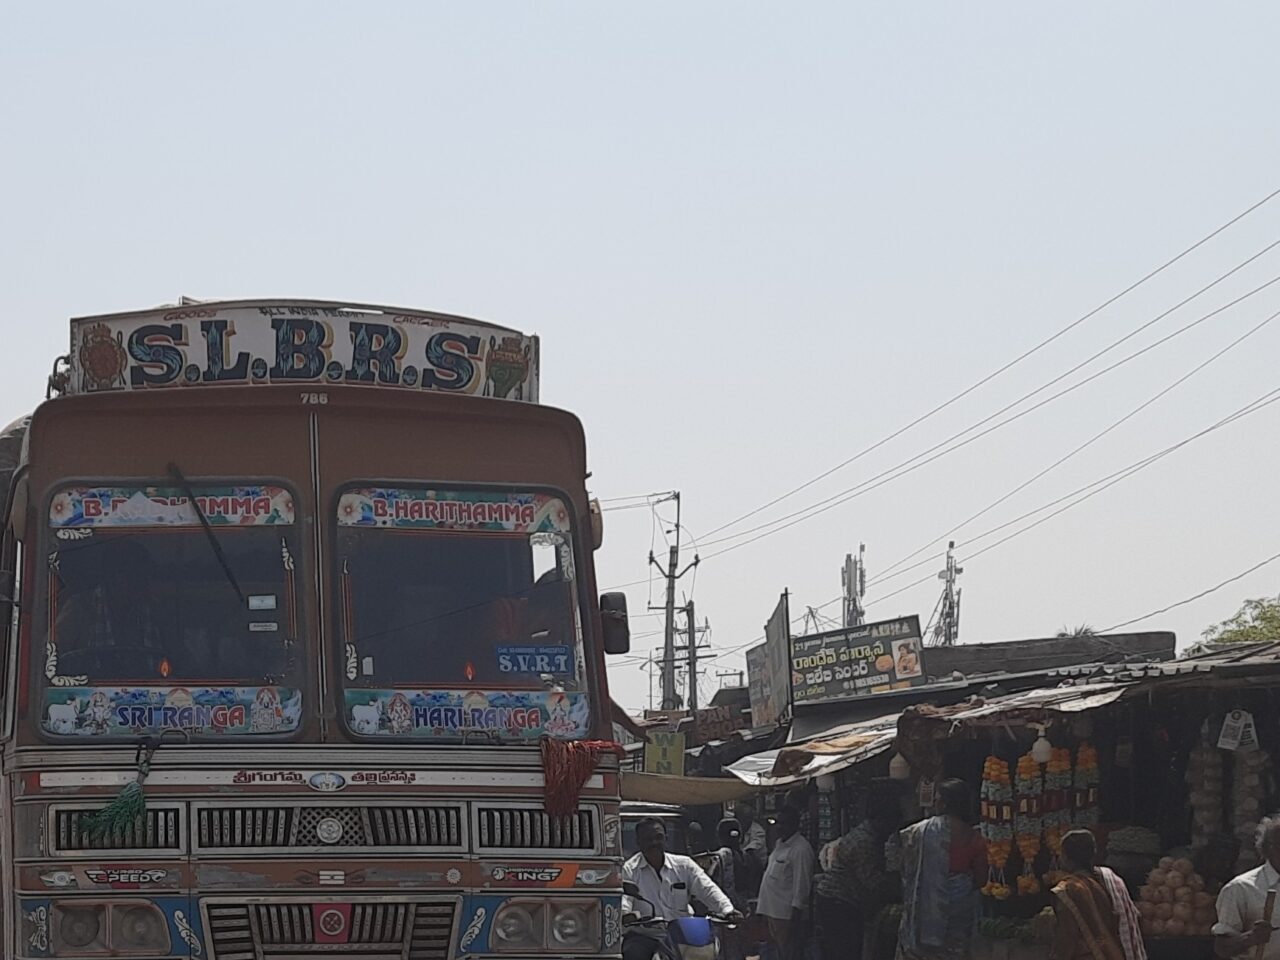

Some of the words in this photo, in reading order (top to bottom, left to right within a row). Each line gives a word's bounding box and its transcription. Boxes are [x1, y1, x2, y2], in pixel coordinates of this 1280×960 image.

[163, 309, 218, 321] GOODS
[300, 393, 328, 404] 786
[373, 499, 535, 524] B.HARITHAMMA
[117, 705, 155, 728] SRI
[161, 705, 245, 728] RANGA
[414, 706, 463, 729] HARI
[471, 707, 541, 729] RANGA
